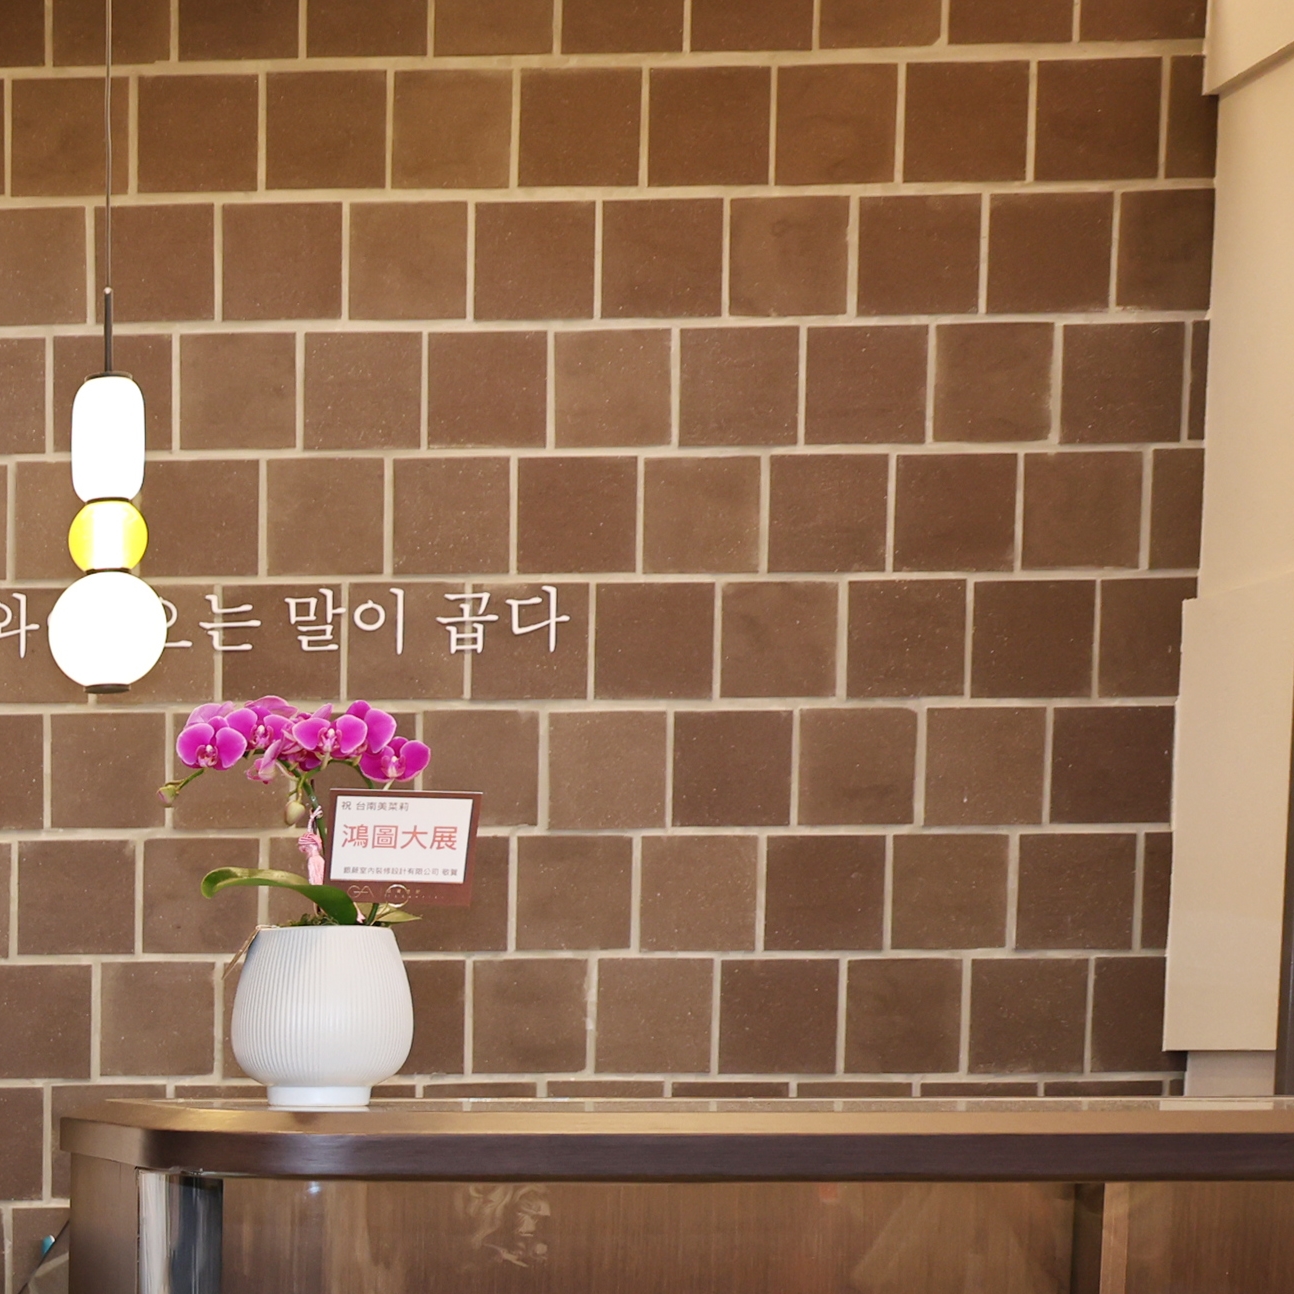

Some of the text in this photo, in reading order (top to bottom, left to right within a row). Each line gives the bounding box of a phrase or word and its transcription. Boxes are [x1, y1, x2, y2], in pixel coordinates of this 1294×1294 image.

[284, 588, 407, 656] 말이
[435, 585, 571, 655] 곱다
[342, 800, 352, 811] 祝
[340, 824, 458, 851] 鴻圖大展
